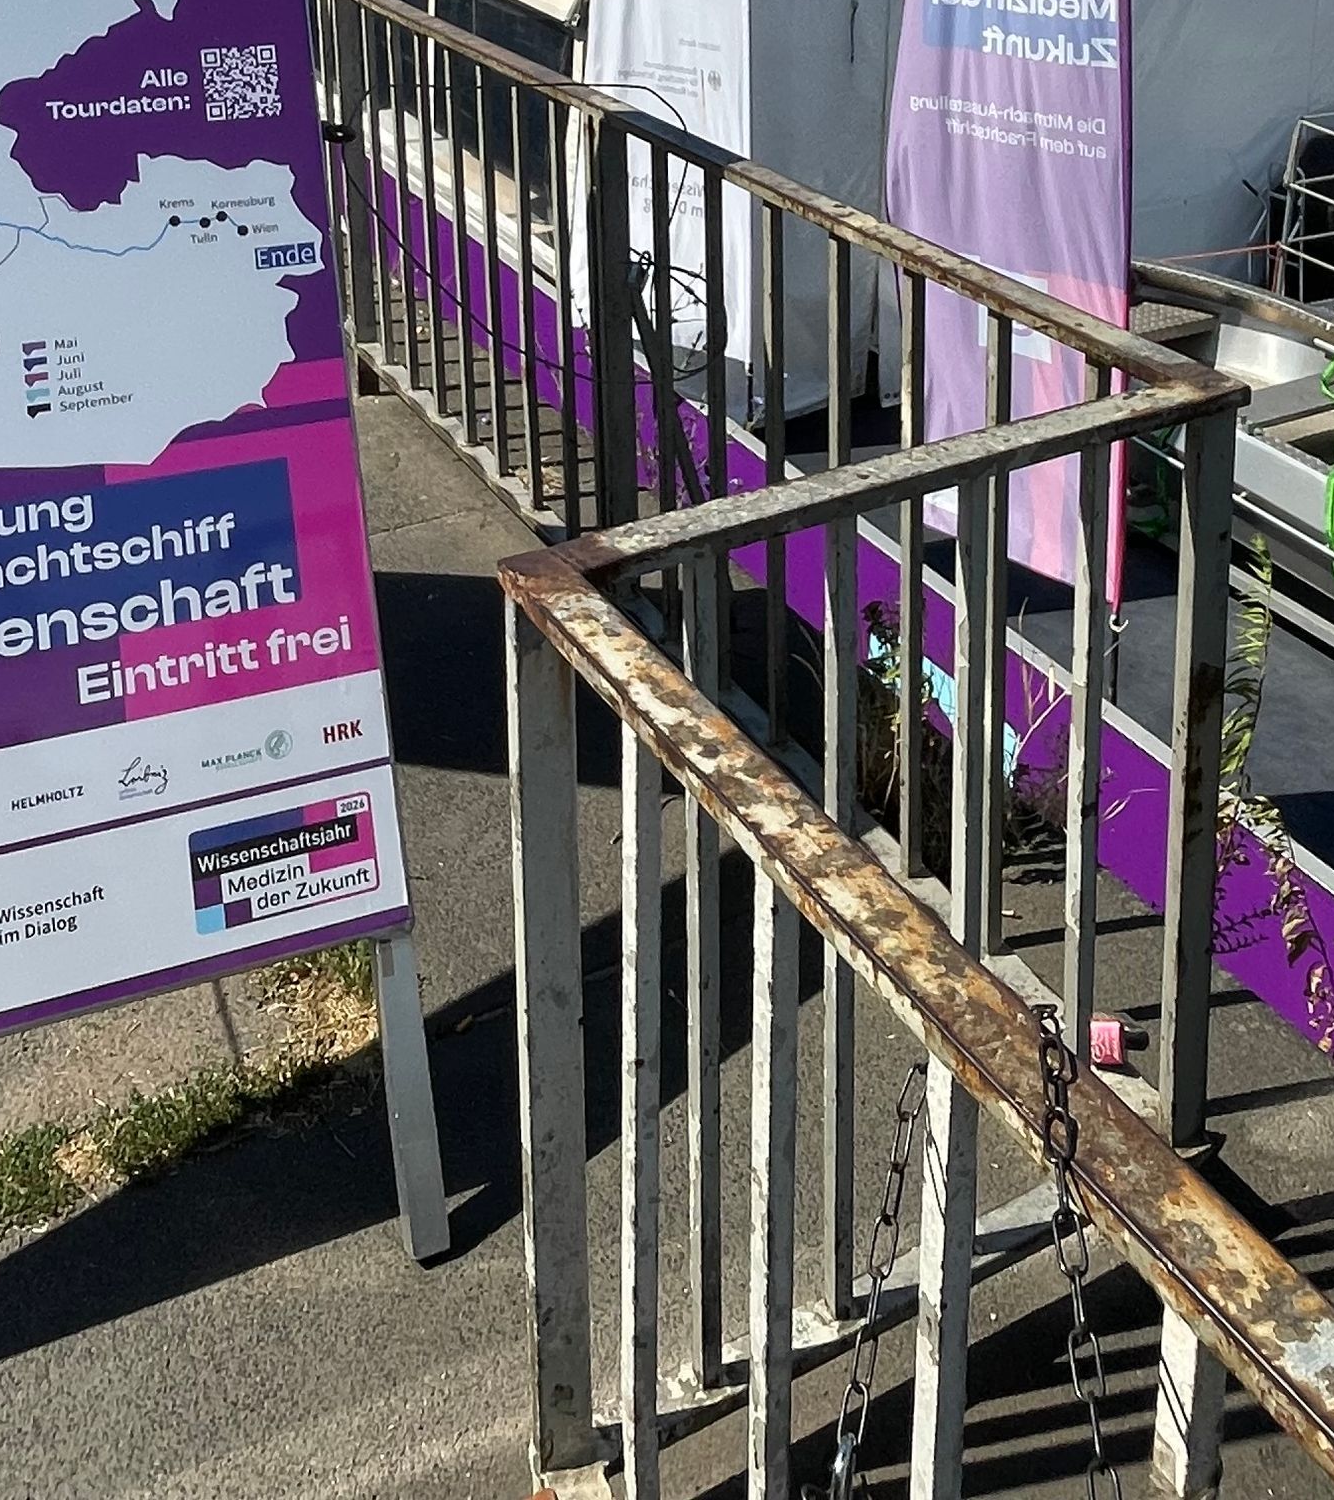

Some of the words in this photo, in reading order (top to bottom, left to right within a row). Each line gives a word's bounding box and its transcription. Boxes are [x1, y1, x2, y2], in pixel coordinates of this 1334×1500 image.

[139, 69, 189, 89] Alle
[45, 95, 191, 120] Tourdaten:
[159, 196, 195, 209] Krems
[210, 194, 276, 210] Korneuburg
[190, 233, 218, 245] Tulln
[251, 223, 279, 235] Wien
[257, 245, 316, 268] Ende
[54, 337, 78, 350] Mai
[57, 352, 85, 366] Juni
[58, 367, 82, 381] Juli
[58, 380, 104, 396] August
[59, 393, 134, 412] September
[76, 632, 261, 706] Eintritt
[267, 615, 354, 667] frei
[322, 719, 363, 744] HRK
[201, 757, 223, 769] MAX
[225, 748, 263, 764] PLANCK
[11, 785, 85, 811] HELMHOLTZ
[340, 799, 366, 814] 2026
[197, 822, 352, 874] Wissenschaftsjahr
[228, 863, 305, 896] Medizin
[257, 889, 291, 910] der
[296, 867, 370, 901] Zukunft
[24, 912, 79, 941] Dialog
